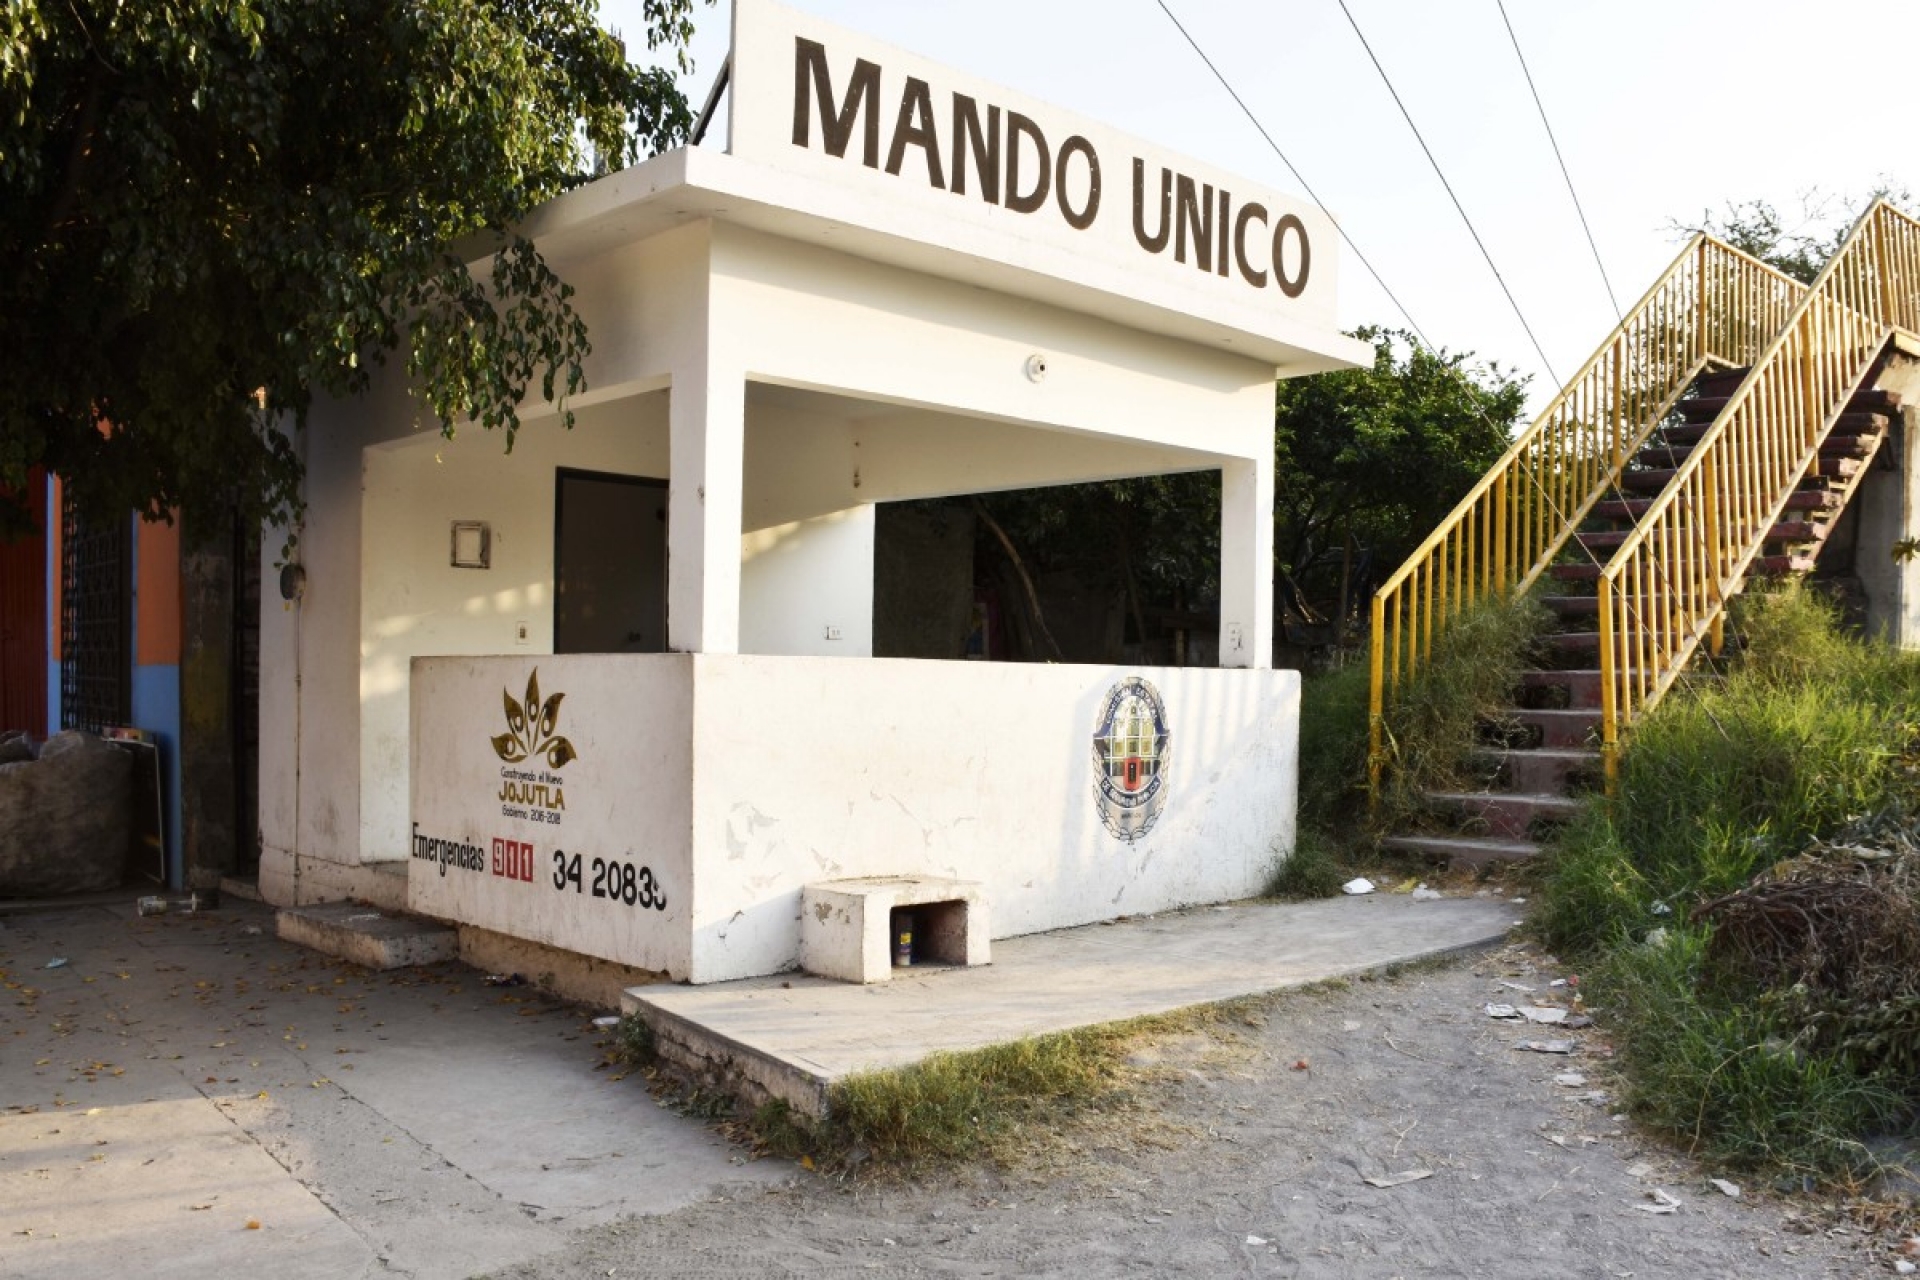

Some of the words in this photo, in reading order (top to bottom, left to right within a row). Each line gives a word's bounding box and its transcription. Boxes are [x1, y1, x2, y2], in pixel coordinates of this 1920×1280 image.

[792, 35, 1101, 231] MANDO
[1132, 156, 1311, 299] UNICO
[498, 780, 566, 811] JOJUTLA
[502, 804, 528, 820] Gobierno
[412, 821, 485, 877] Emergencias
[492, 837, 534, 882] 911
[553, 849, 582, 894] 34
